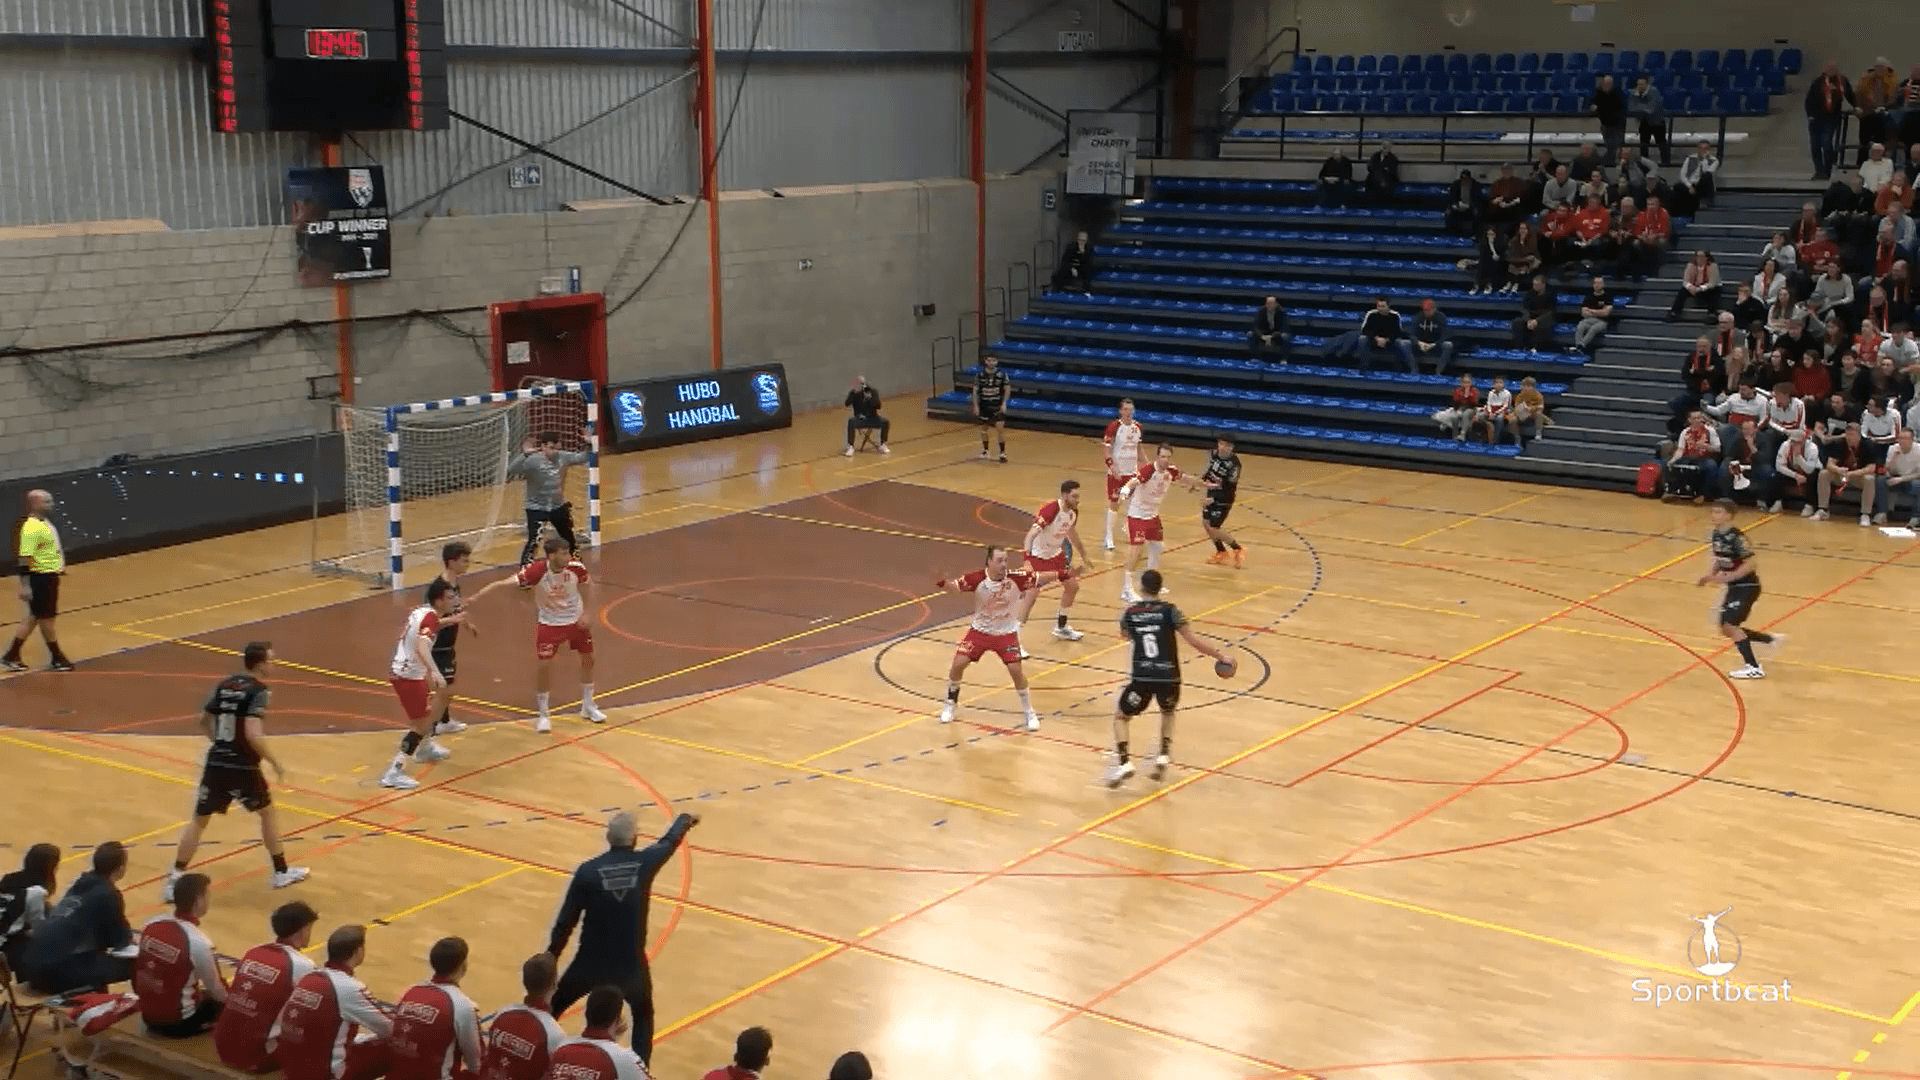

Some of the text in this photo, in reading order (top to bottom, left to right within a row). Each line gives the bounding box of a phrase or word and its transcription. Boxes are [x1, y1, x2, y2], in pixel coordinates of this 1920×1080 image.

[1091, 139, 1130, 148] CHARITY
[308, 219, 388, 234] CUP WINNER
[679, 381, 720, 402] HUBO
[669, 403, 740, 428] HANDBAL
[1142, 633, 1159, 659] 6
